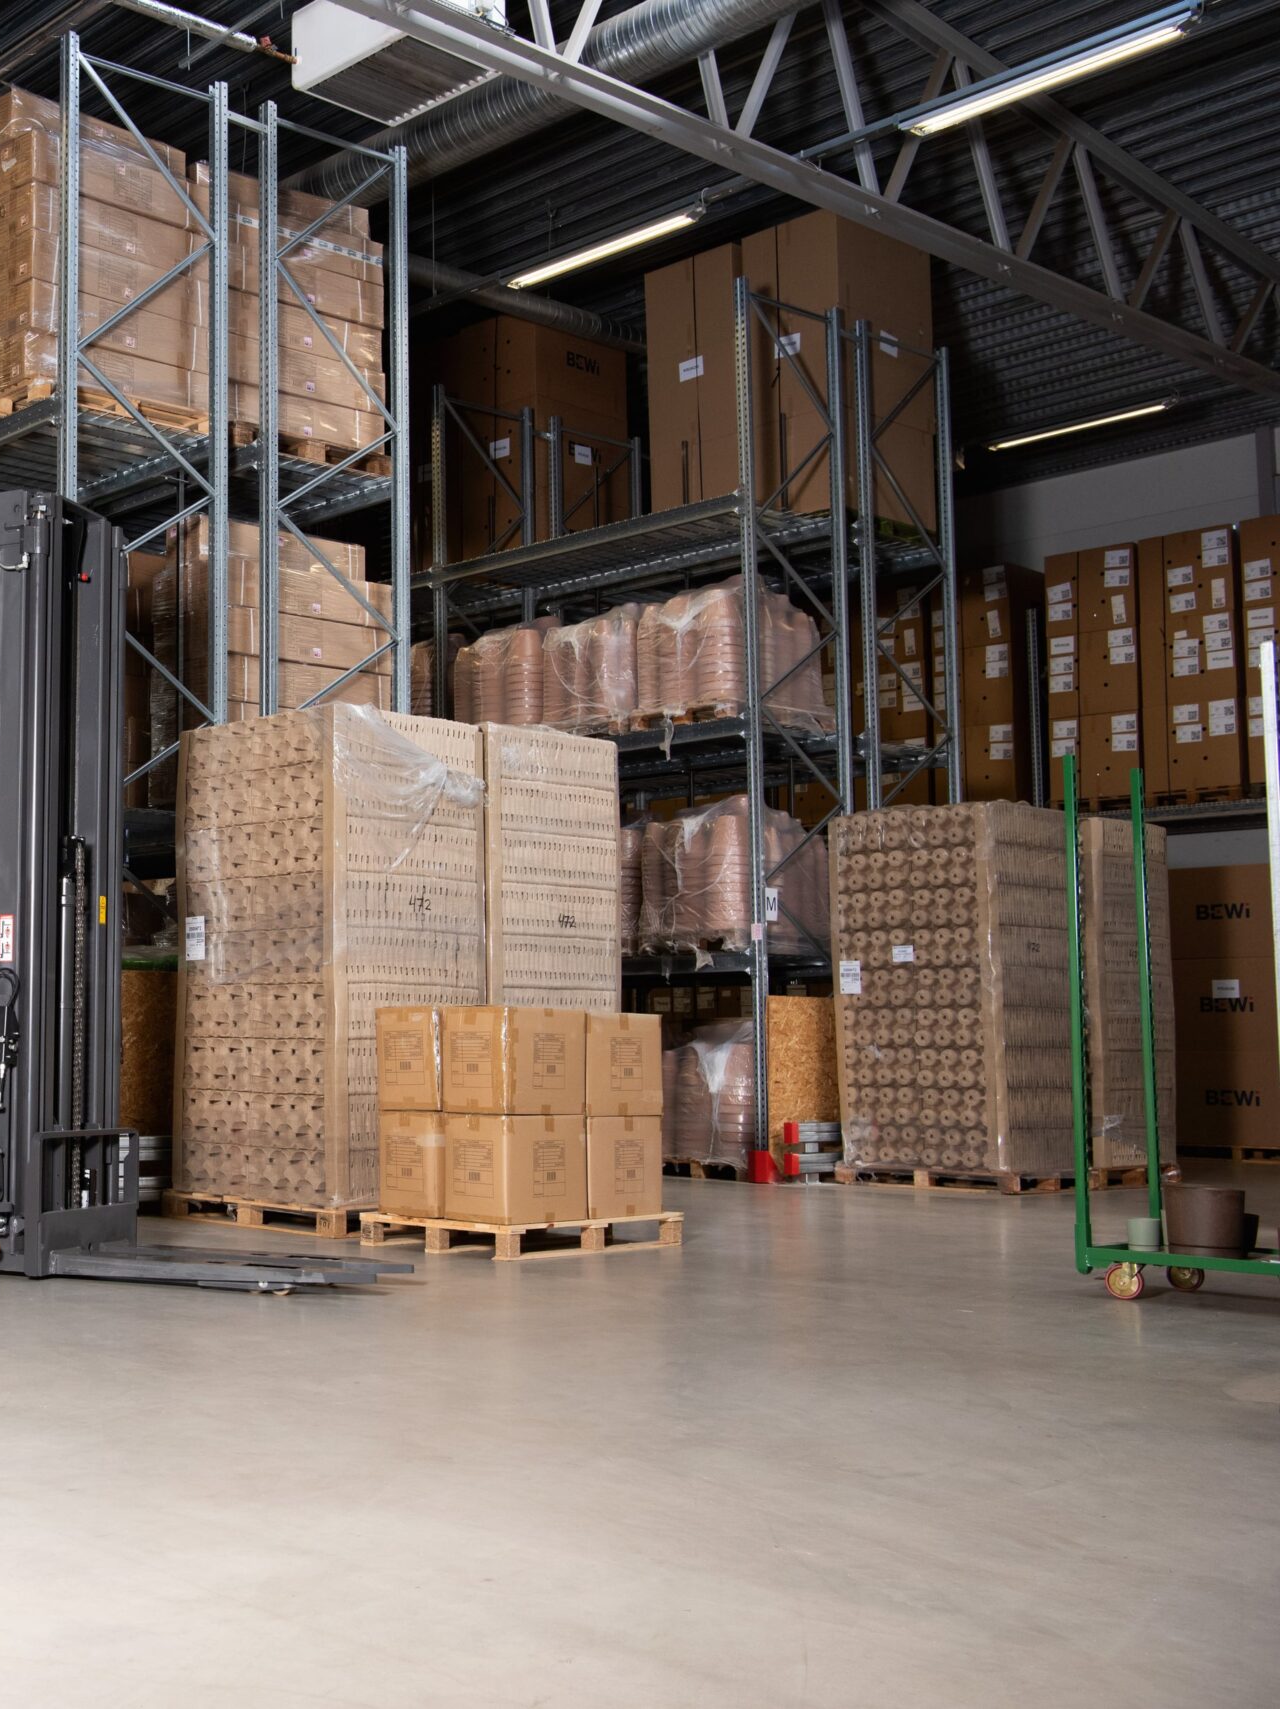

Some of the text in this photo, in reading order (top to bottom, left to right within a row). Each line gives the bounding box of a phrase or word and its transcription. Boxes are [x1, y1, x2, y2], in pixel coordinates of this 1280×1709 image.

[567, 351, 600, 376] BEWi
[409, 894, 431, 912] 472
[766, 896, 777, 912] M
[1196, 903, 1250, 921] BEWi
[558, 913, 577, 928] 472
[1200, 996, 1254, 1013] BEWi
[1205, 1089, 1260, 1108] BEWi
